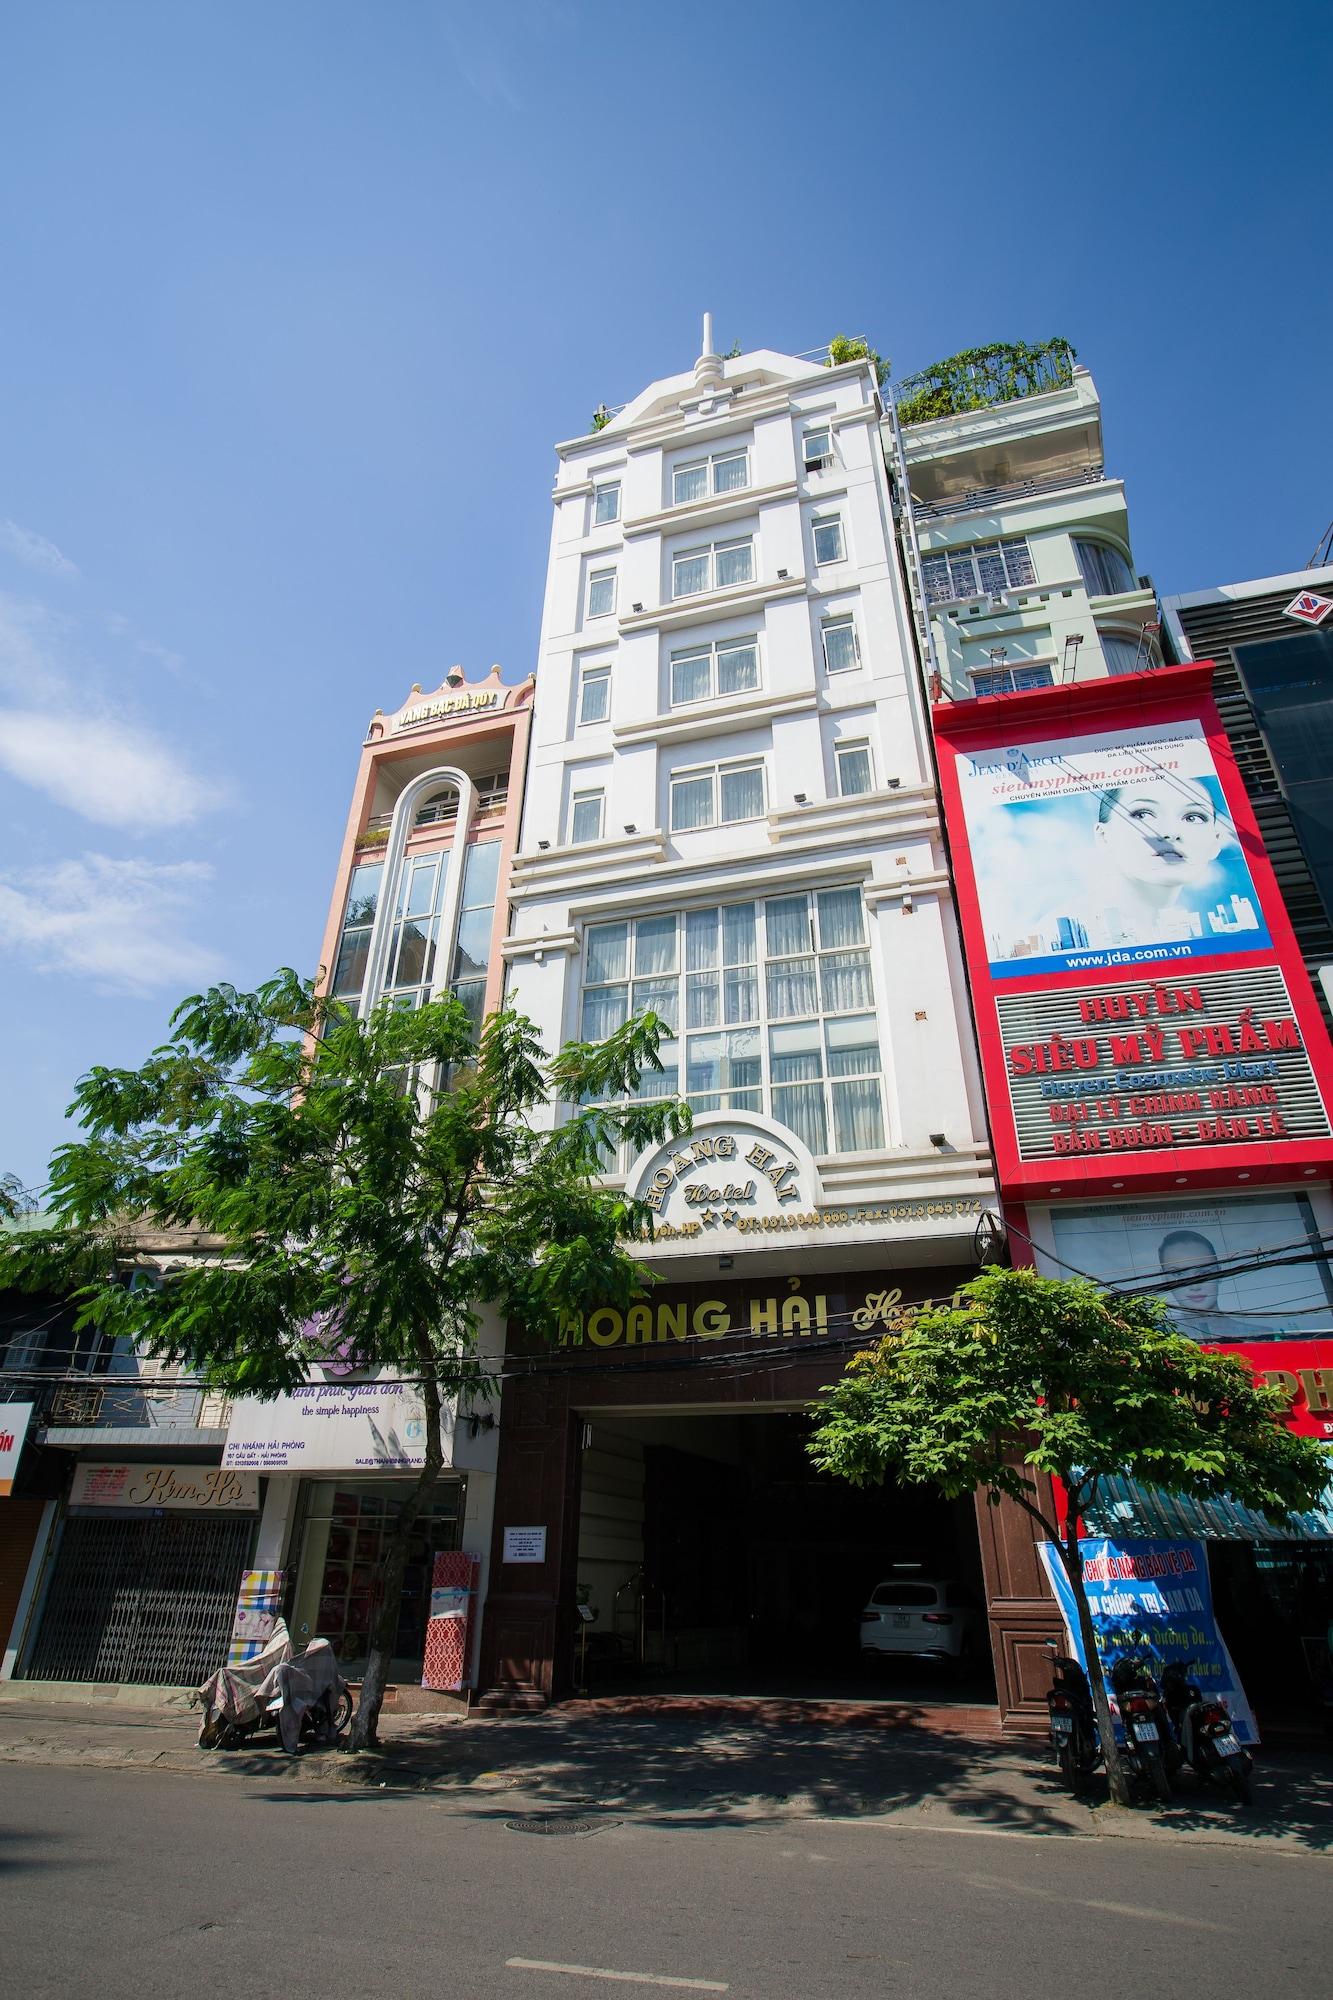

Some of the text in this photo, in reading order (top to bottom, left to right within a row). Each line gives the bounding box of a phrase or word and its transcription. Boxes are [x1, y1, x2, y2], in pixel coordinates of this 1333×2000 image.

[969, 759, 1002, 777] JEAN
[992, 760, 1179, 794] sieumypham.com.vn
[1009, 792, 1041, 801] CHUYÊN
[1042, 789, 1061, 797] KINH
[1064, 784, 1090, 794] DOANH
[1130, 777, 1148, 785] CAO
[1066, 945, 1192, 967] www.jda.com.vn
[1077, 981, 1204, 1022] HUYỀN
[1010, 1007, 1301, 1076] SIÊU MỸ PHẨM
[1040, 1059, 1280, 1099] Huyen Cosmetic Mart
[1129, 1089, 1201, 1116] CHÍNH
[1208, 1083, 1279, 1109] HÀNG
[1107, 1120, 1174, 1148] BUÔN
[644, 1136, 797, 1212] HOÀNG HẢI
[684, 1180, 754, 1203] Hotel
[750, 1276, 830, 1340] HẢI
[302, 1404, 380, 1418] the simple happiness
[228, 1439, 305, 1450] CHI NHÁNH HẢI PHÒNG
[129, 1468, 196, 1505] Kim
[197, 1469, 246, 1507] Hà
[1184, 1587, 1205, 1612] DA
